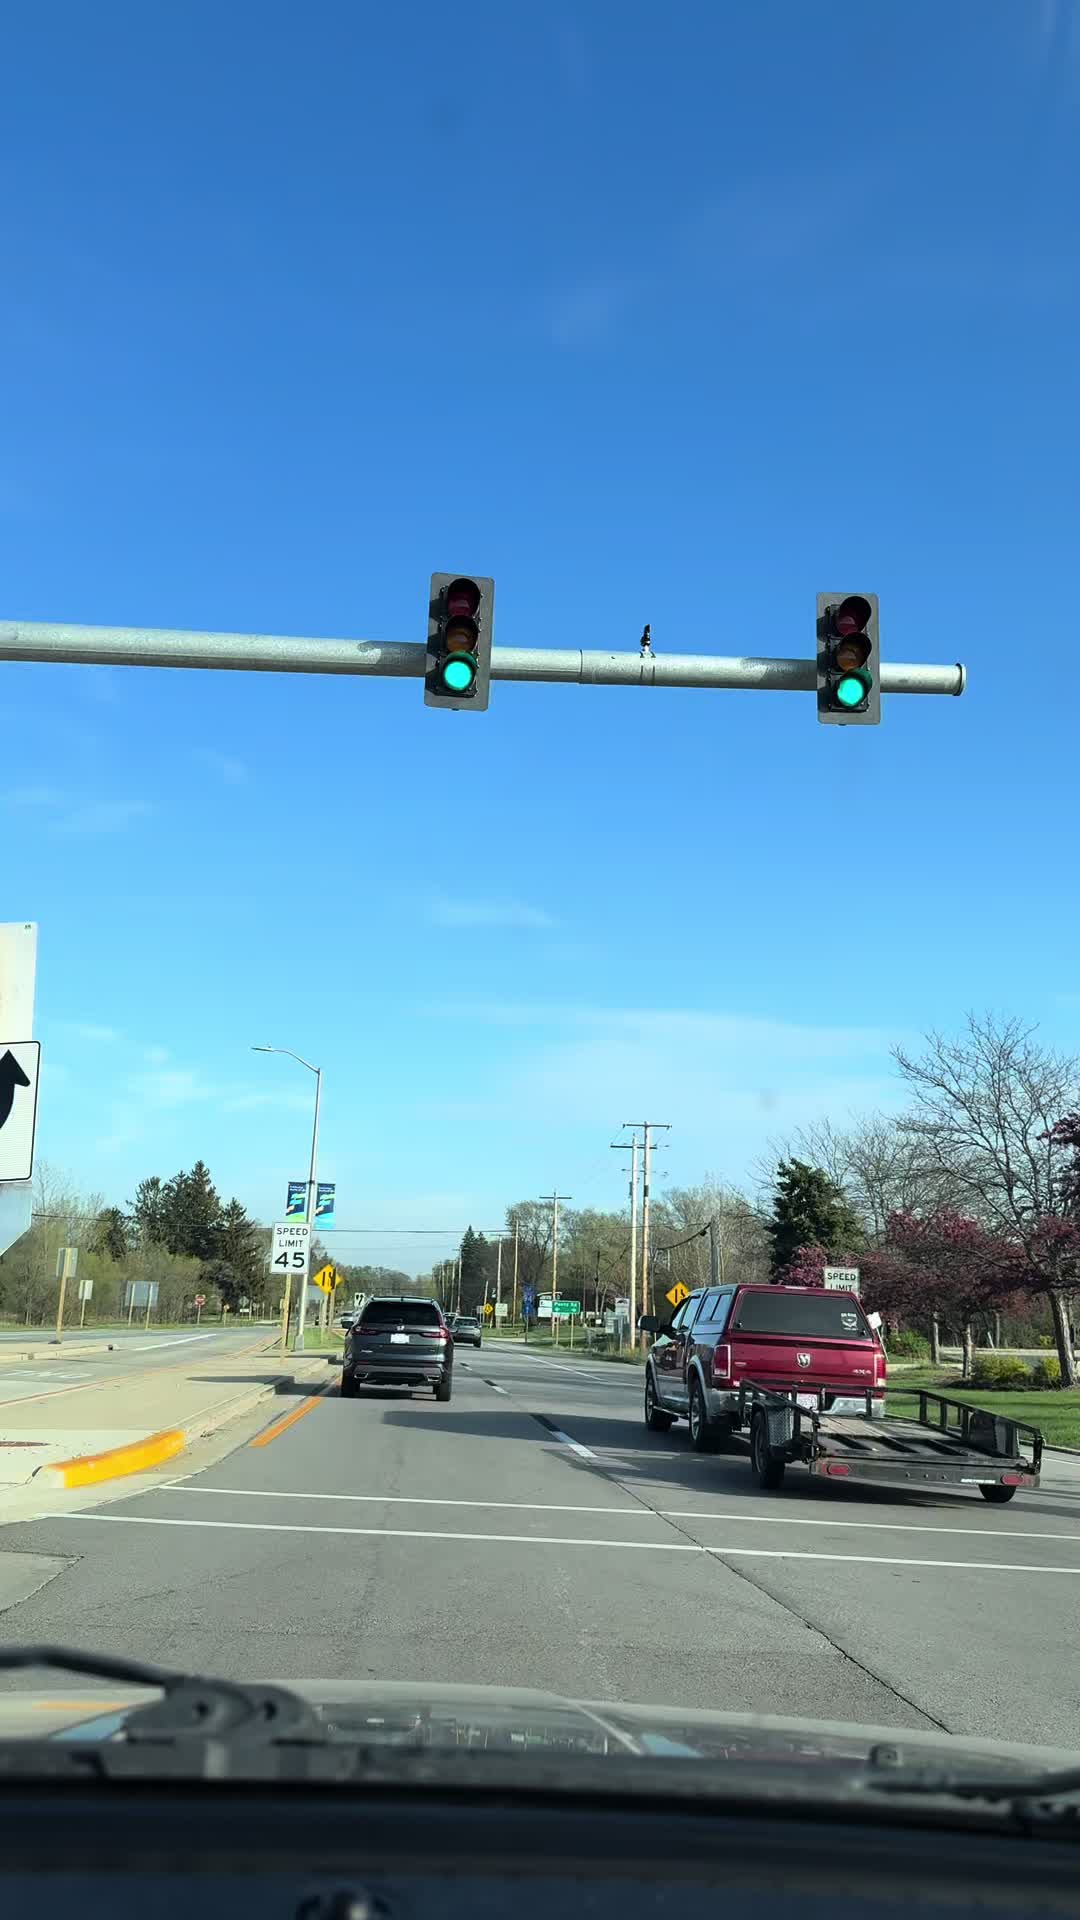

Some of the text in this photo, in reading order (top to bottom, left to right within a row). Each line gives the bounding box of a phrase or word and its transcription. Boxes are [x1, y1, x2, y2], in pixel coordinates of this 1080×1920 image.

[276, 1227, 308, 1236] SPEED
[279, 1239, 304, 1248] LIMIT
[275, 1252, 305, 1268] 45
[827, 1272, 857, 1281] SPEED
[830, 1284, 853, 1292] LIMIT
